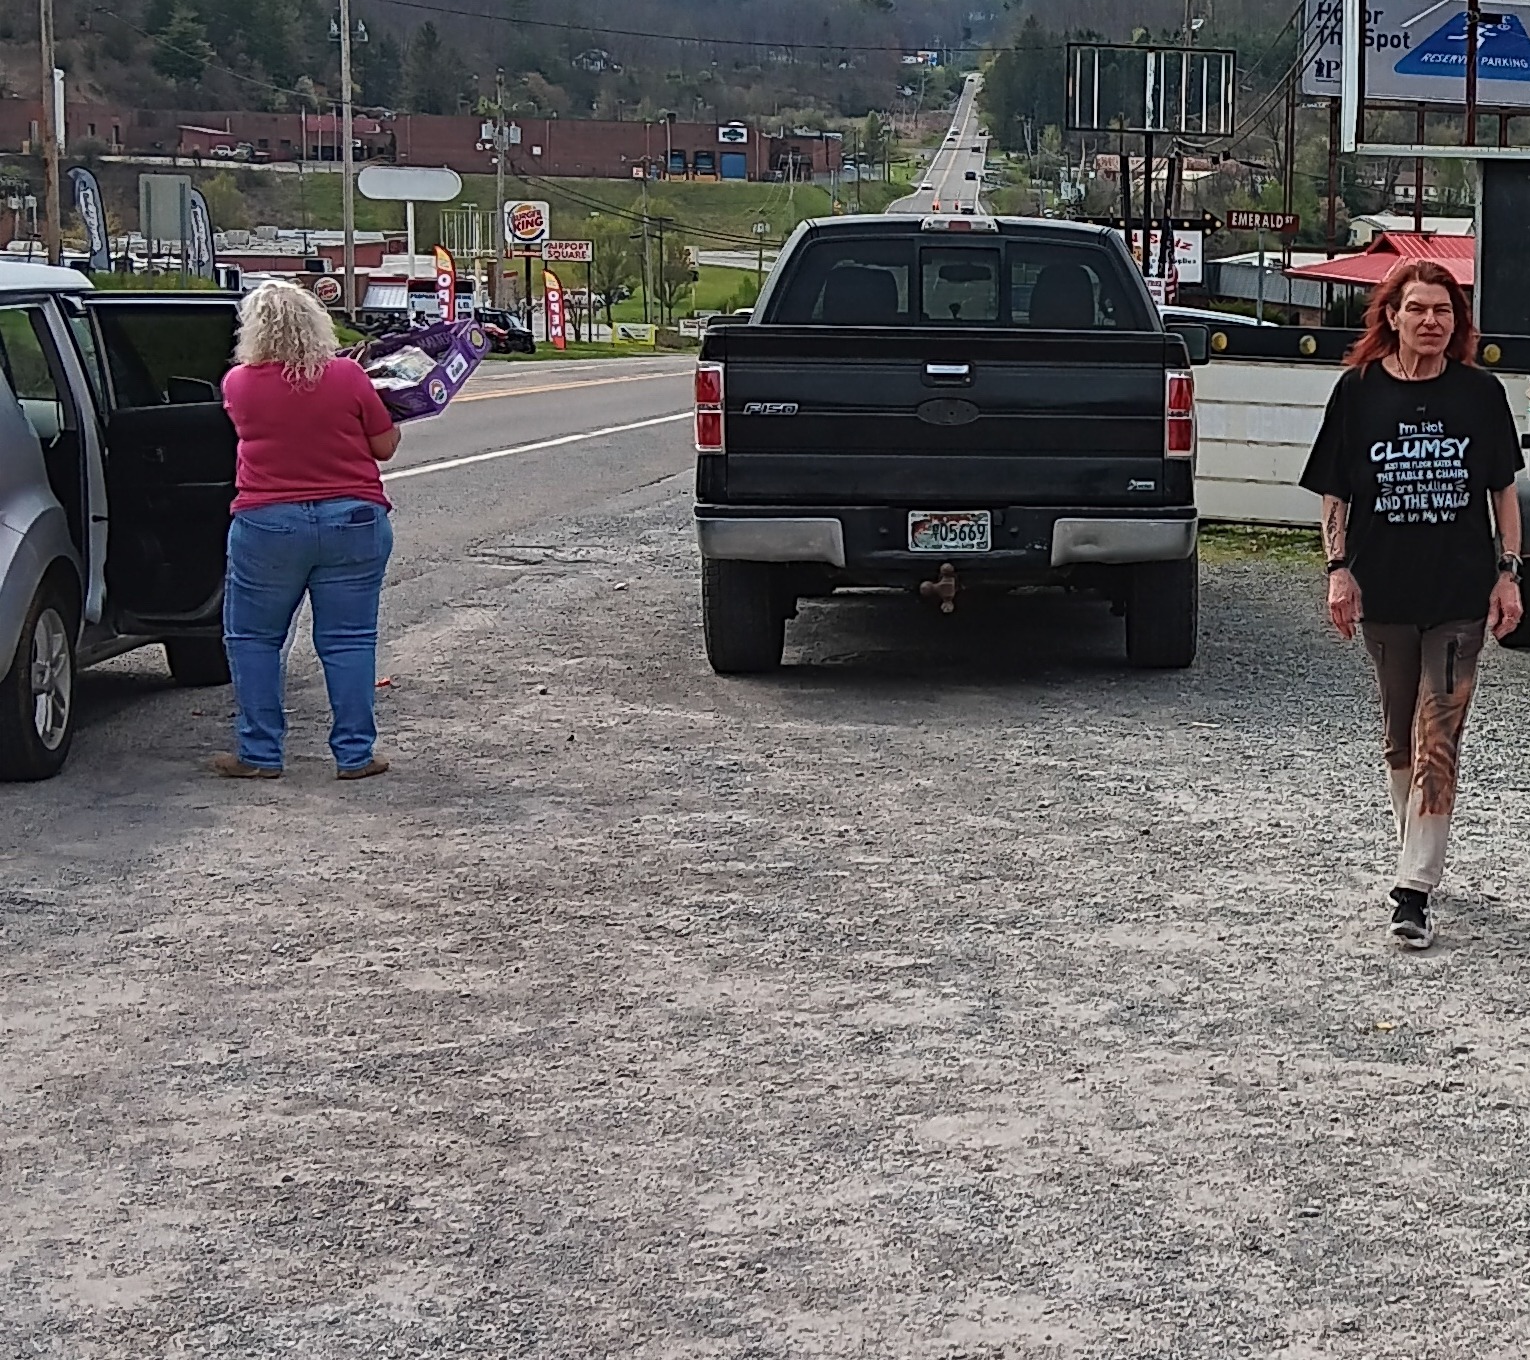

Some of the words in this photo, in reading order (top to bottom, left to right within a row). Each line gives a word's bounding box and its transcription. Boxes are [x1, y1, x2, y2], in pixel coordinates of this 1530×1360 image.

[1317, 3, 1383, 24] Hoor
[1364, 30, 1411, 52] Spot
[1481, 56, 1529, 68] PARKING
[513, 217, 544, 232] KING
[1231, 212, 1284, 229] EMERALD
[548, 242, 590, 251] AIRPORT
[547, 250, 588, 260] SQUARE
[1421, 420, 1444, 433] Not
[1370, 437, 1470, 462] CLUMSY
[1376, 472, 1394, 483] THE
[1395, 470, 1424, 481] TABLE
[1426, 470, 1434, 479] &
[1436, 469, 1469, 479] CHAIRS
[1395, 484, 1413, 494] are
[1417, 481, 1453, 492] bullies
[1374, 495, 1400, 512] AND
[1403, 494, 1429, 510] THE
[1431, 492, 1470, 508] WALLS
[1422, 510, 1437, 523] My
